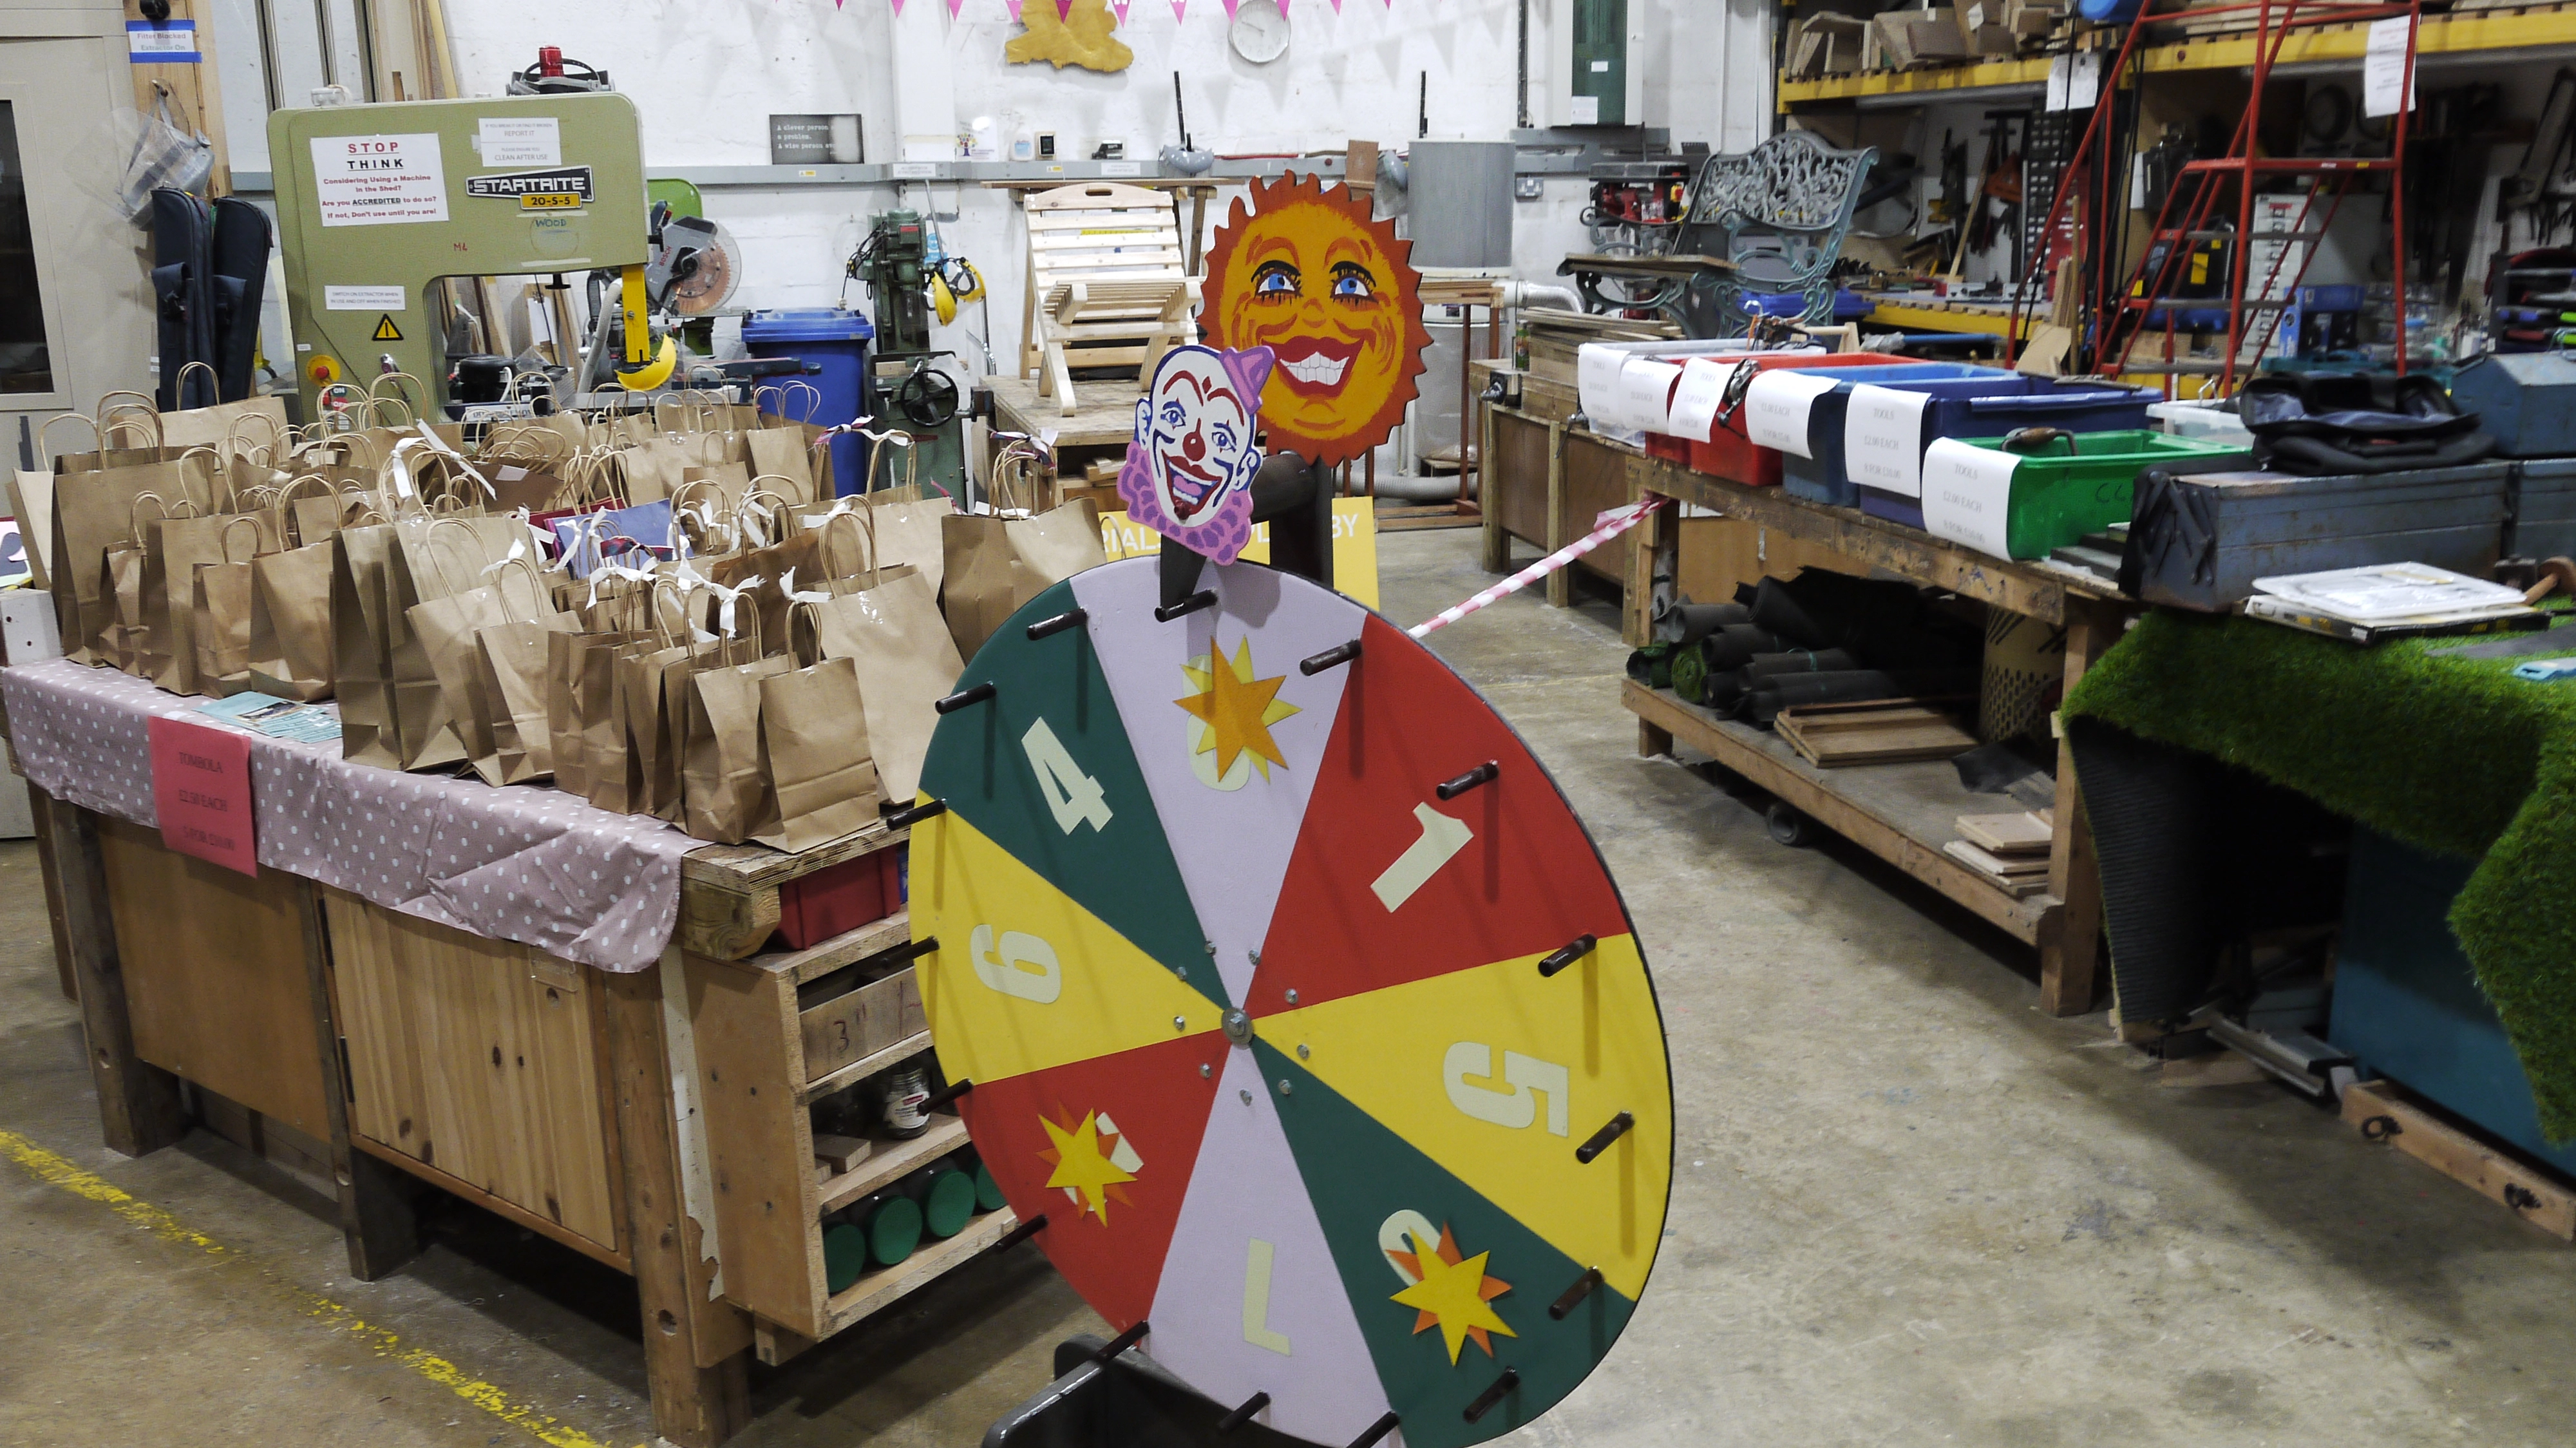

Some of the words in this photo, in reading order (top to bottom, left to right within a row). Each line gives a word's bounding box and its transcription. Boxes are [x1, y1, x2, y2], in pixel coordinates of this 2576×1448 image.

[348, 142, 398, 153] STOP
[347, 158, 404, 169] THINK
[474, 177, 585, 193] STARTRITE
[535, 218, 567, 227] WOOD
[659, 246, 672, 266] BOSCH
[1873, 407, 1895, 420] TOOLS
[1880, 437, 1899, 450] EACH
[1954, 462, 1979, 481] TOOLS
[1961, 495, 1982, 513] EACH
[178, 752, 224, 774] TOMBOLA
[1021, 716, 1113, 835] 4
[201, 794, 228, 812] EACH
[1370, 801, 1473, 913] 1
[1443, 1040, 1569, 1137] 5
